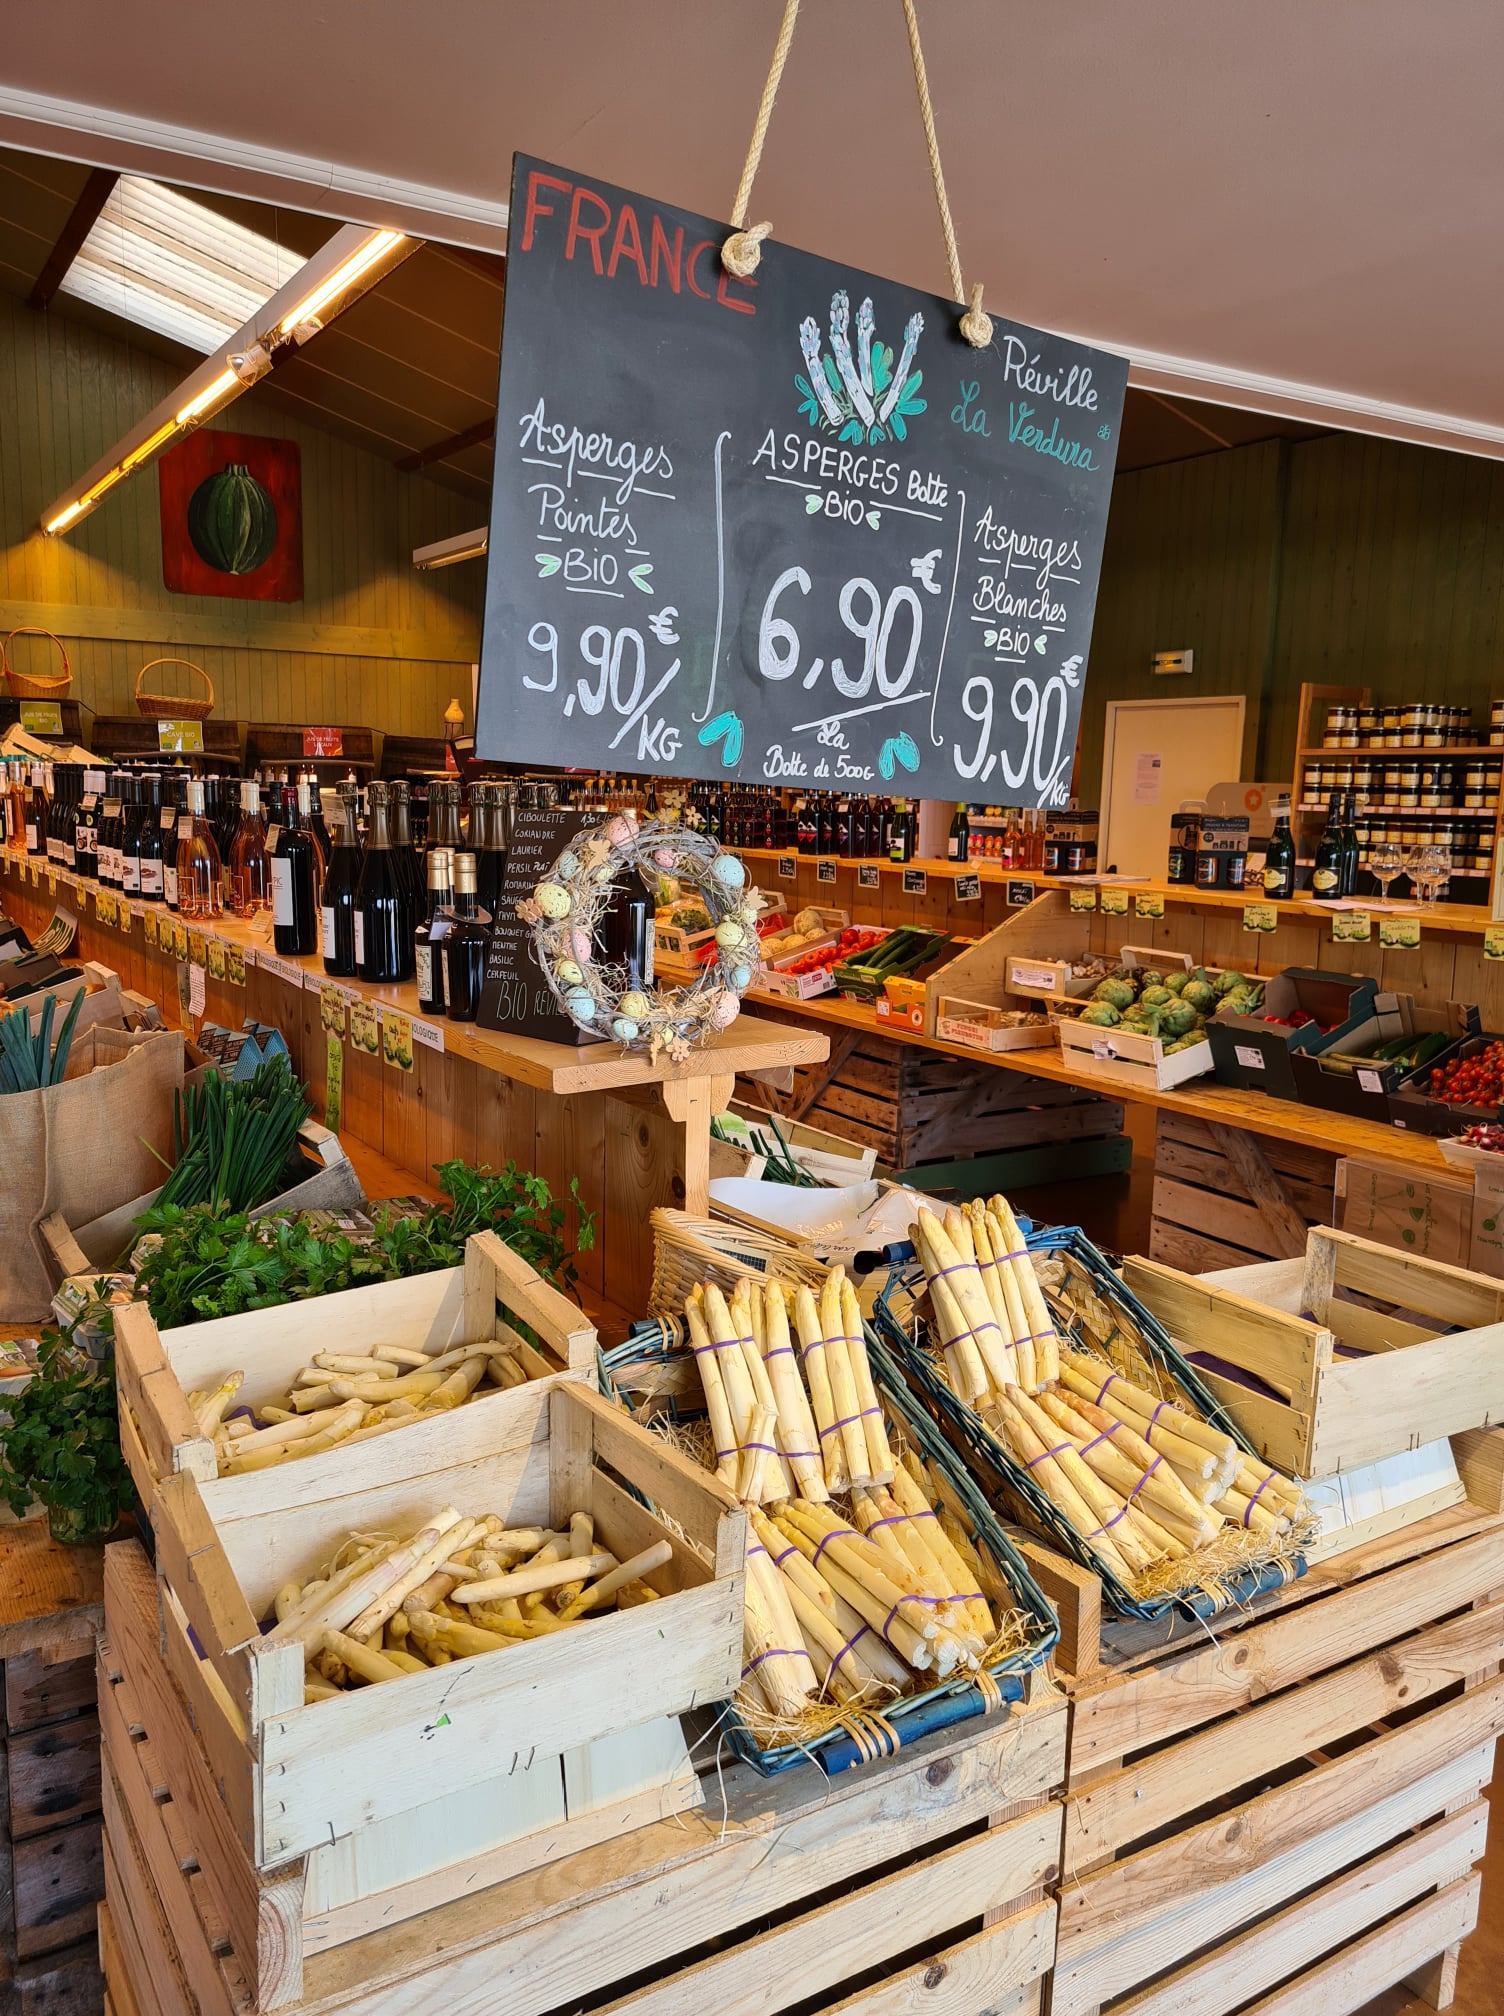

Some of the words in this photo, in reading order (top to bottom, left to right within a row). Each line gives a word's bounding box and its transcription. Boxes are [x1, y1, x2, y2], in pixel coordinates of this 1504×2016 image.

[520, 170, 759, 315] FRANCE
[1003, 335, 1098, 411] Réville
[950, 379, 991, 438] La
[1008, 401, 1100, 471] Verdura
[519, 397, 674, 504] Asperges
[752, 428, 900, 495] ASPERGES
[907, 470, 948, 507] Botte
[527, 483, 637, 545] Pointes
[973, 505, 1081, 590] Asperges
[972, 575, 1067, 623] Blanches
[816, 720, 850, 749] La
[763, 744, 808, 779] Botte
[813, 757, 830, 779] de
[834, 754, 875, 781] 500G
[518, 812, 566, 824] CIBOULETTE
[514, 828, 556, 840] CORIANDRE
[511, 845, 543, 856] LAURIER
[507, 862, 532, 873] PERSIL
[532, 861, 551, 871] PLAT
[503, 879, 534, 890] ROMARIN
[498, 910, 516, 921] THYM
[492, 941, 518, 951] MENTHE
[494, 926, 524, 937] BOUQUET
[486, 968, 519, 981] CERFEUIL
[489, 955, 514, 965] BASILIC
[496, 980, 529, 1020] BIO
